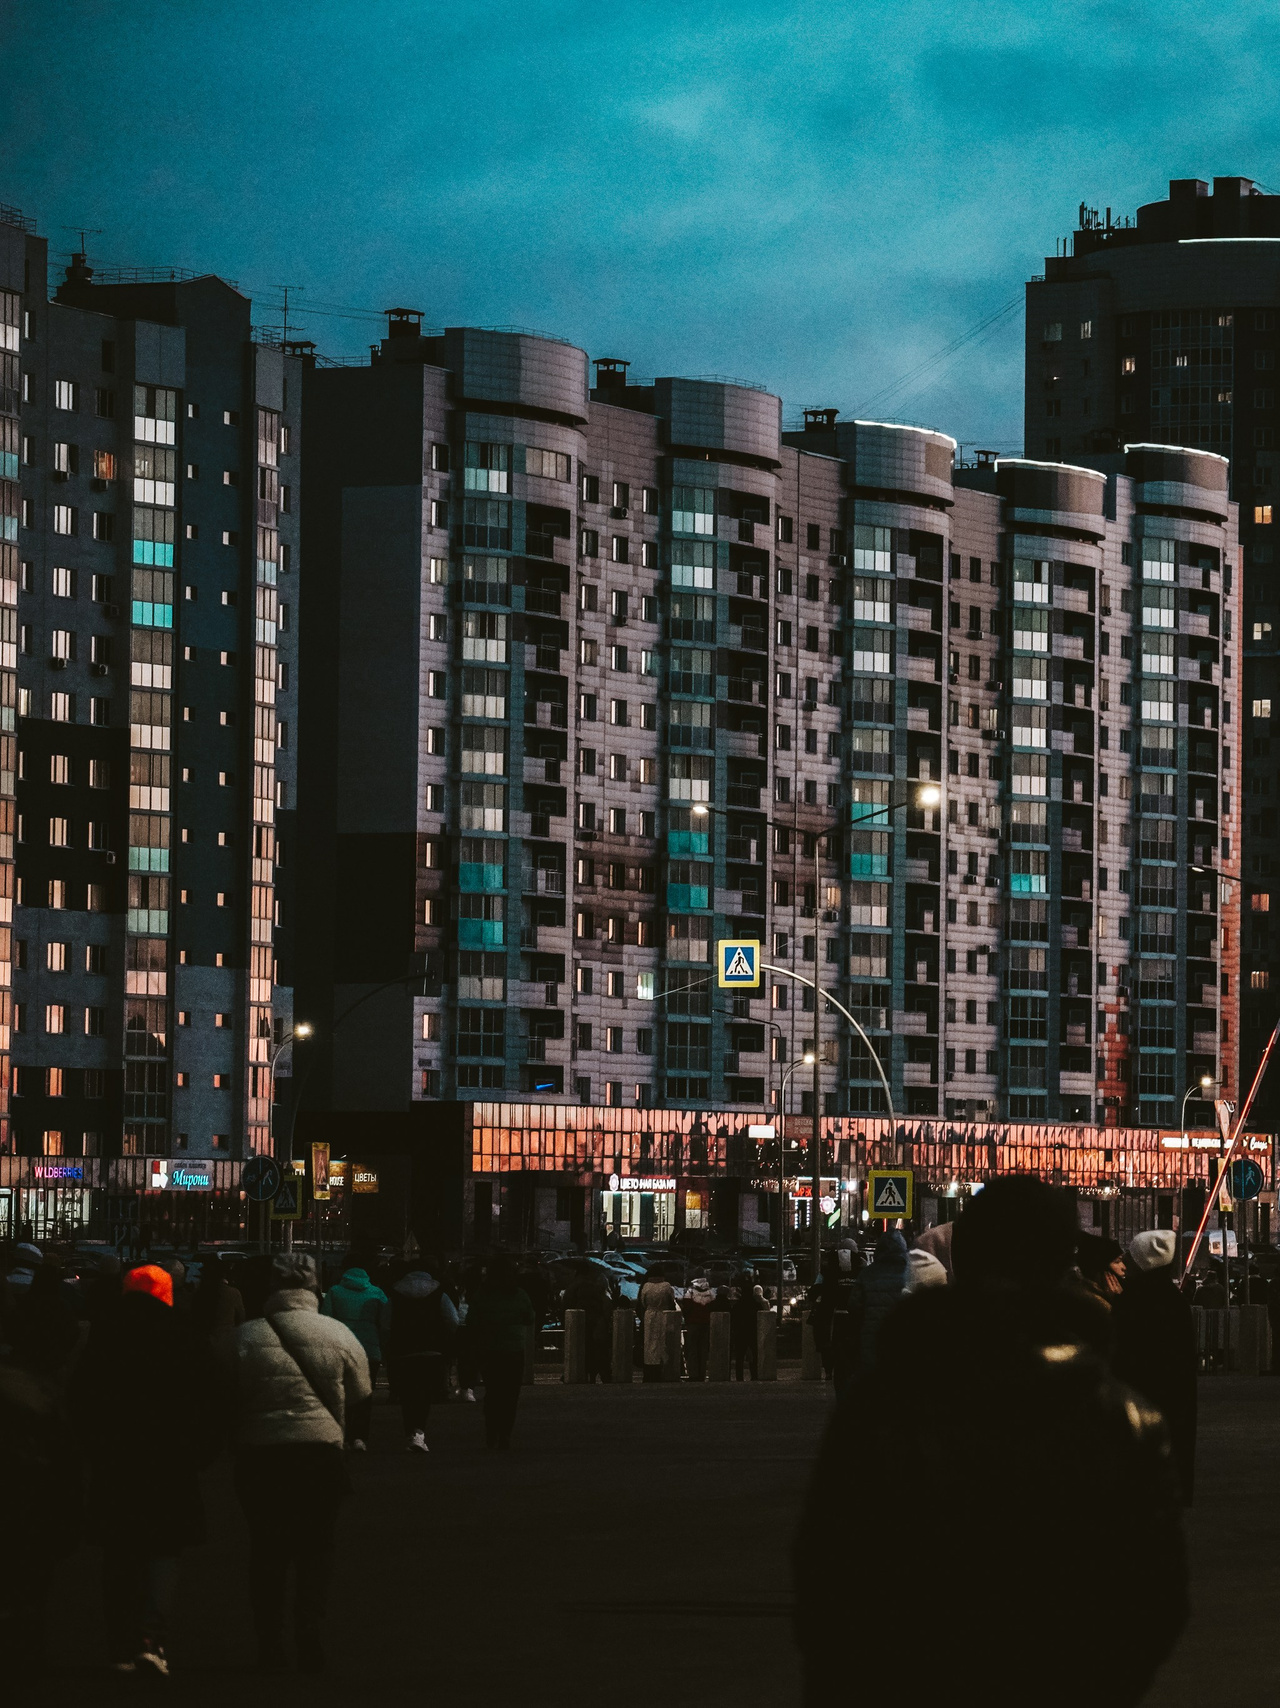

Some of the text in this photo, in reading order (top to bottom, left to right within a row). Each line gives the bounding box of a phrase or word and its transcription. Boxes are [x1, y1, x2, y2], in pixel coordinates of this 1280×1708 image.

[34, 1166, 83, 1179] WLDBERRIES
[354, 1173, 377, 1182] ЦВЕТЫ
[620, 1178, 652, 1190] ЦВЕТОНАЯ
